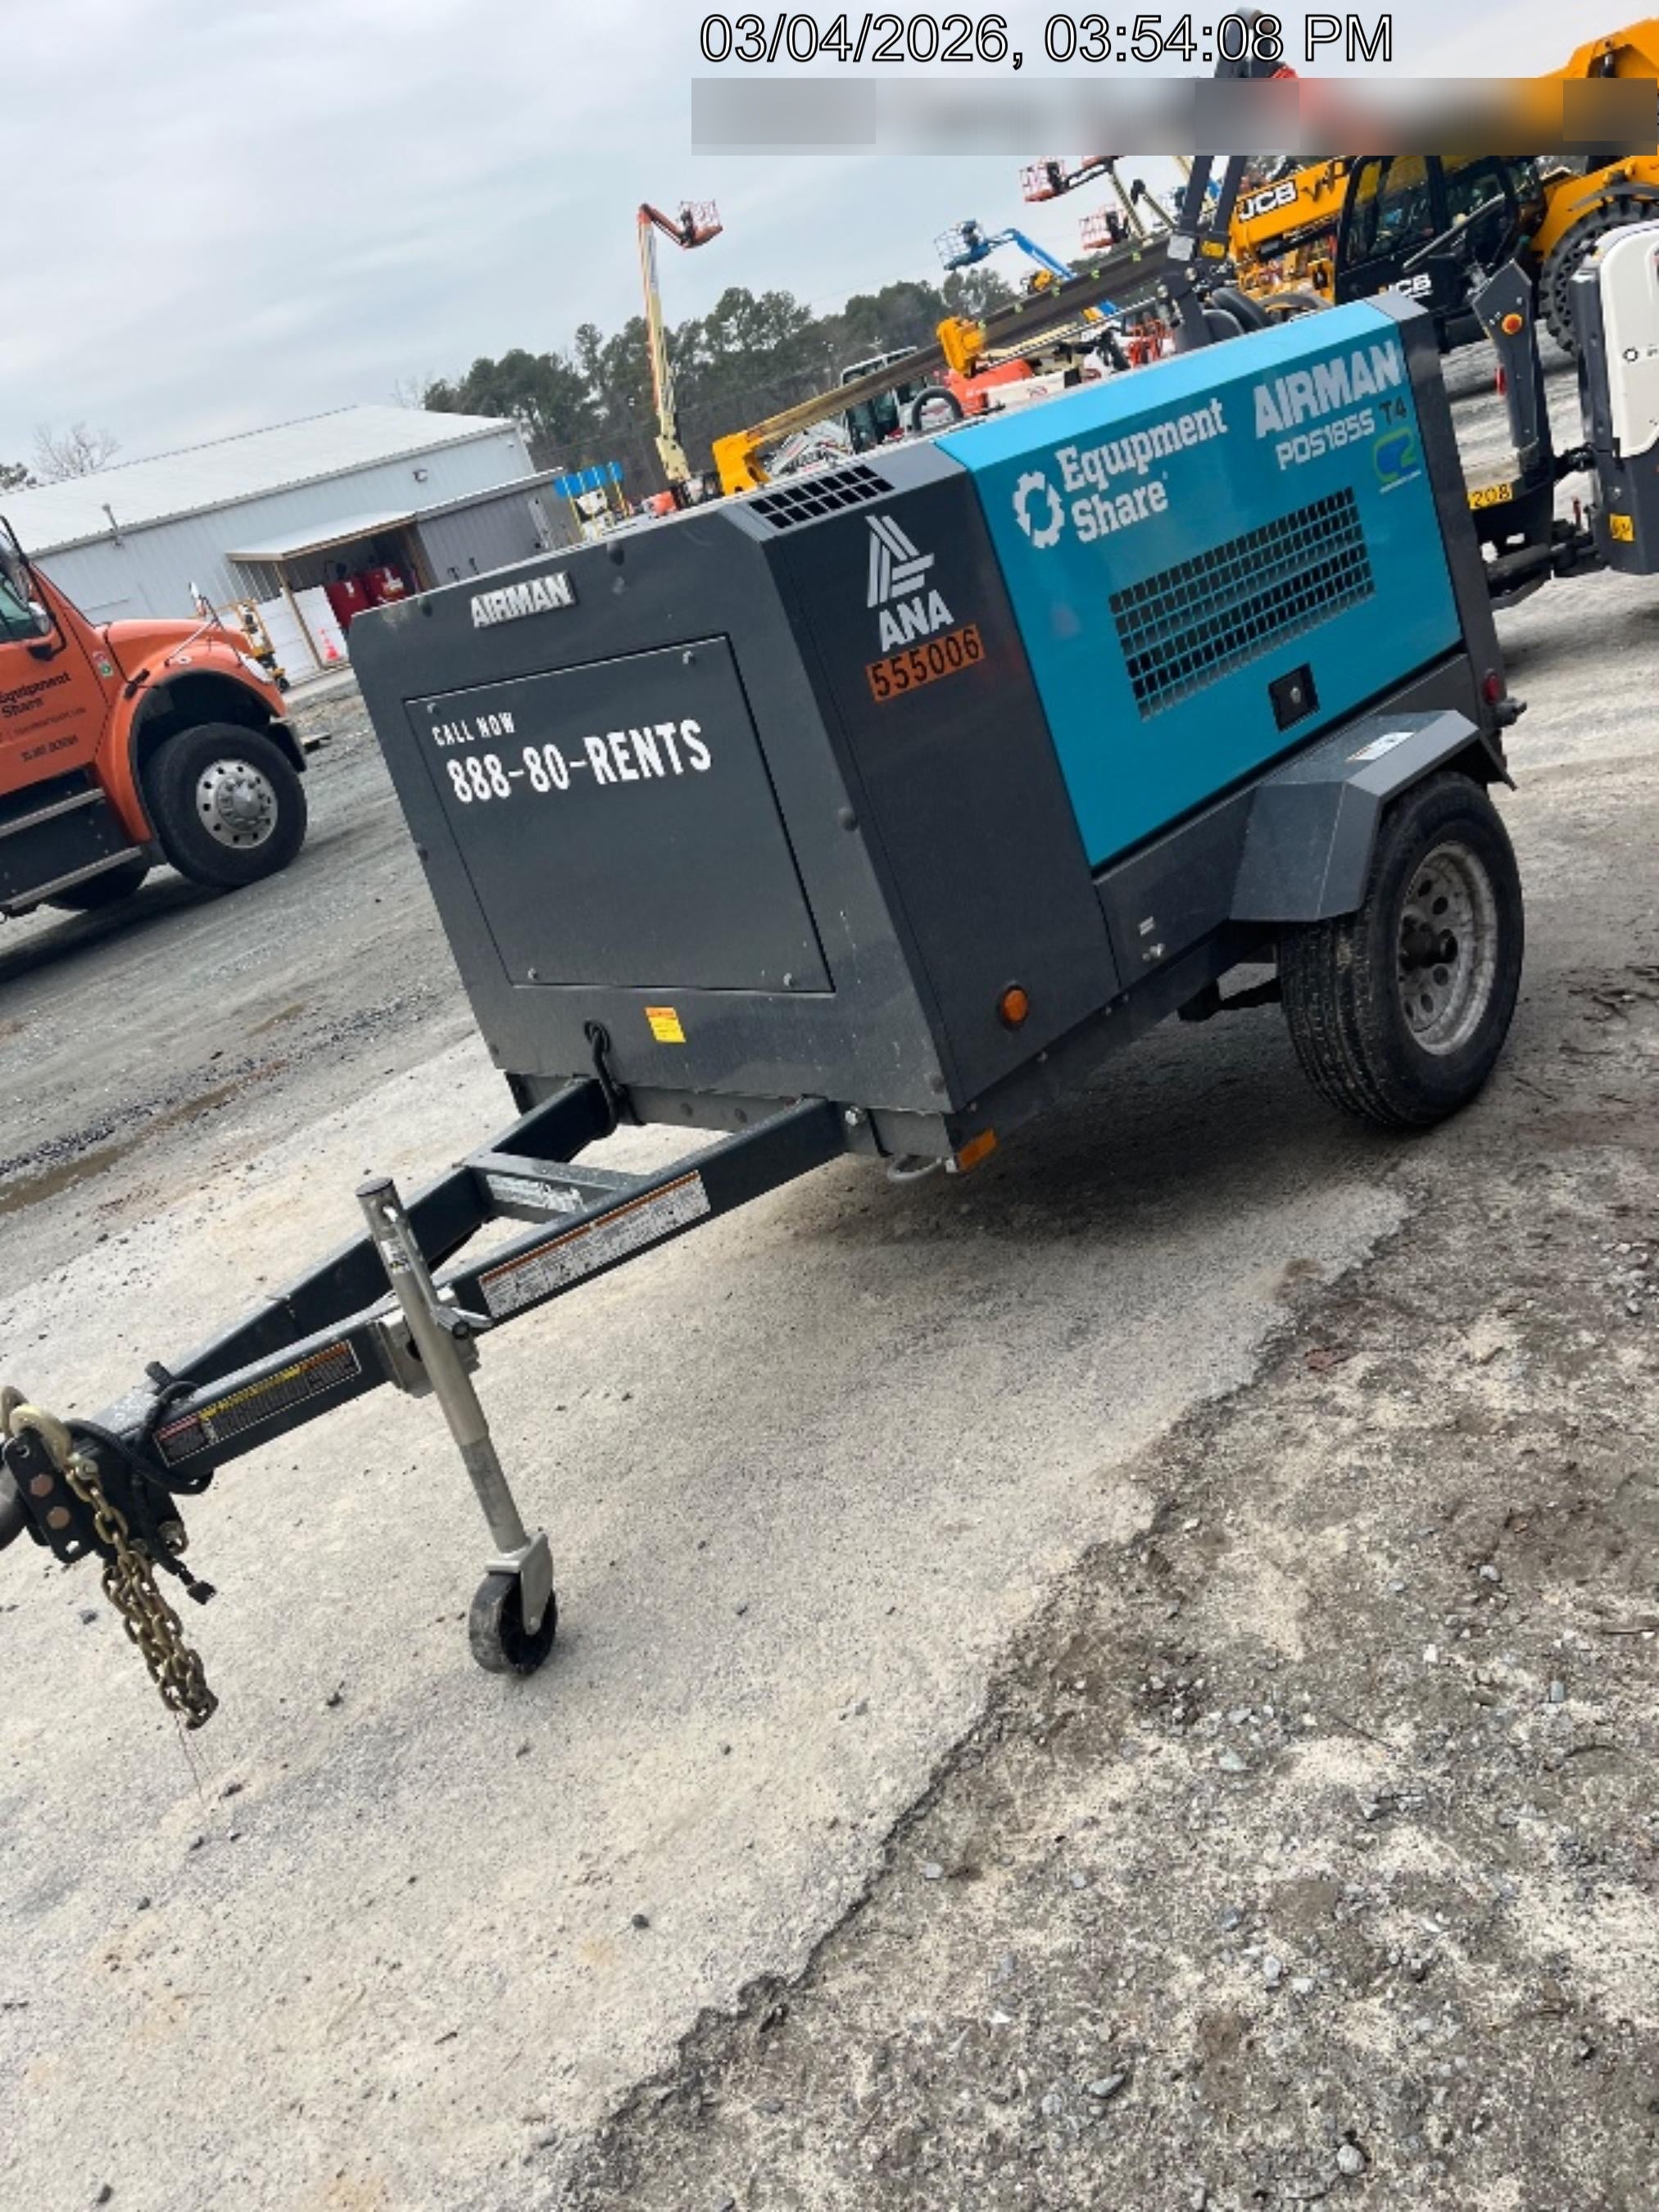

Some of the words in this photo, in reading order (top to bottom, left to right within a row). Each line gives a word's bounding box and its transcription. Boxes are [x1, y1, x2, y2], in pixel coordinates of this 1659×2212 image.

[1238, 179, 1298, 221] JCB
[1253, 340, 1403, 439] AIRMAN
[1054, 397, 1228, 492] Equipment
[1276, 408, 1376, 471] PDS185S
[1379, 396, 1407, 424] T4
[1071, 480, 1169, 542] Share
[470, 571, 575, 628] AIRMAN
[878, 588, 955, 653] ANA
[870, 628, 979, 697] 555006
[431, 719, 475, 747] CALL
[476, 711, 515, 738] NOW
[446, 718, 712, 803] 888-80-RENTS
